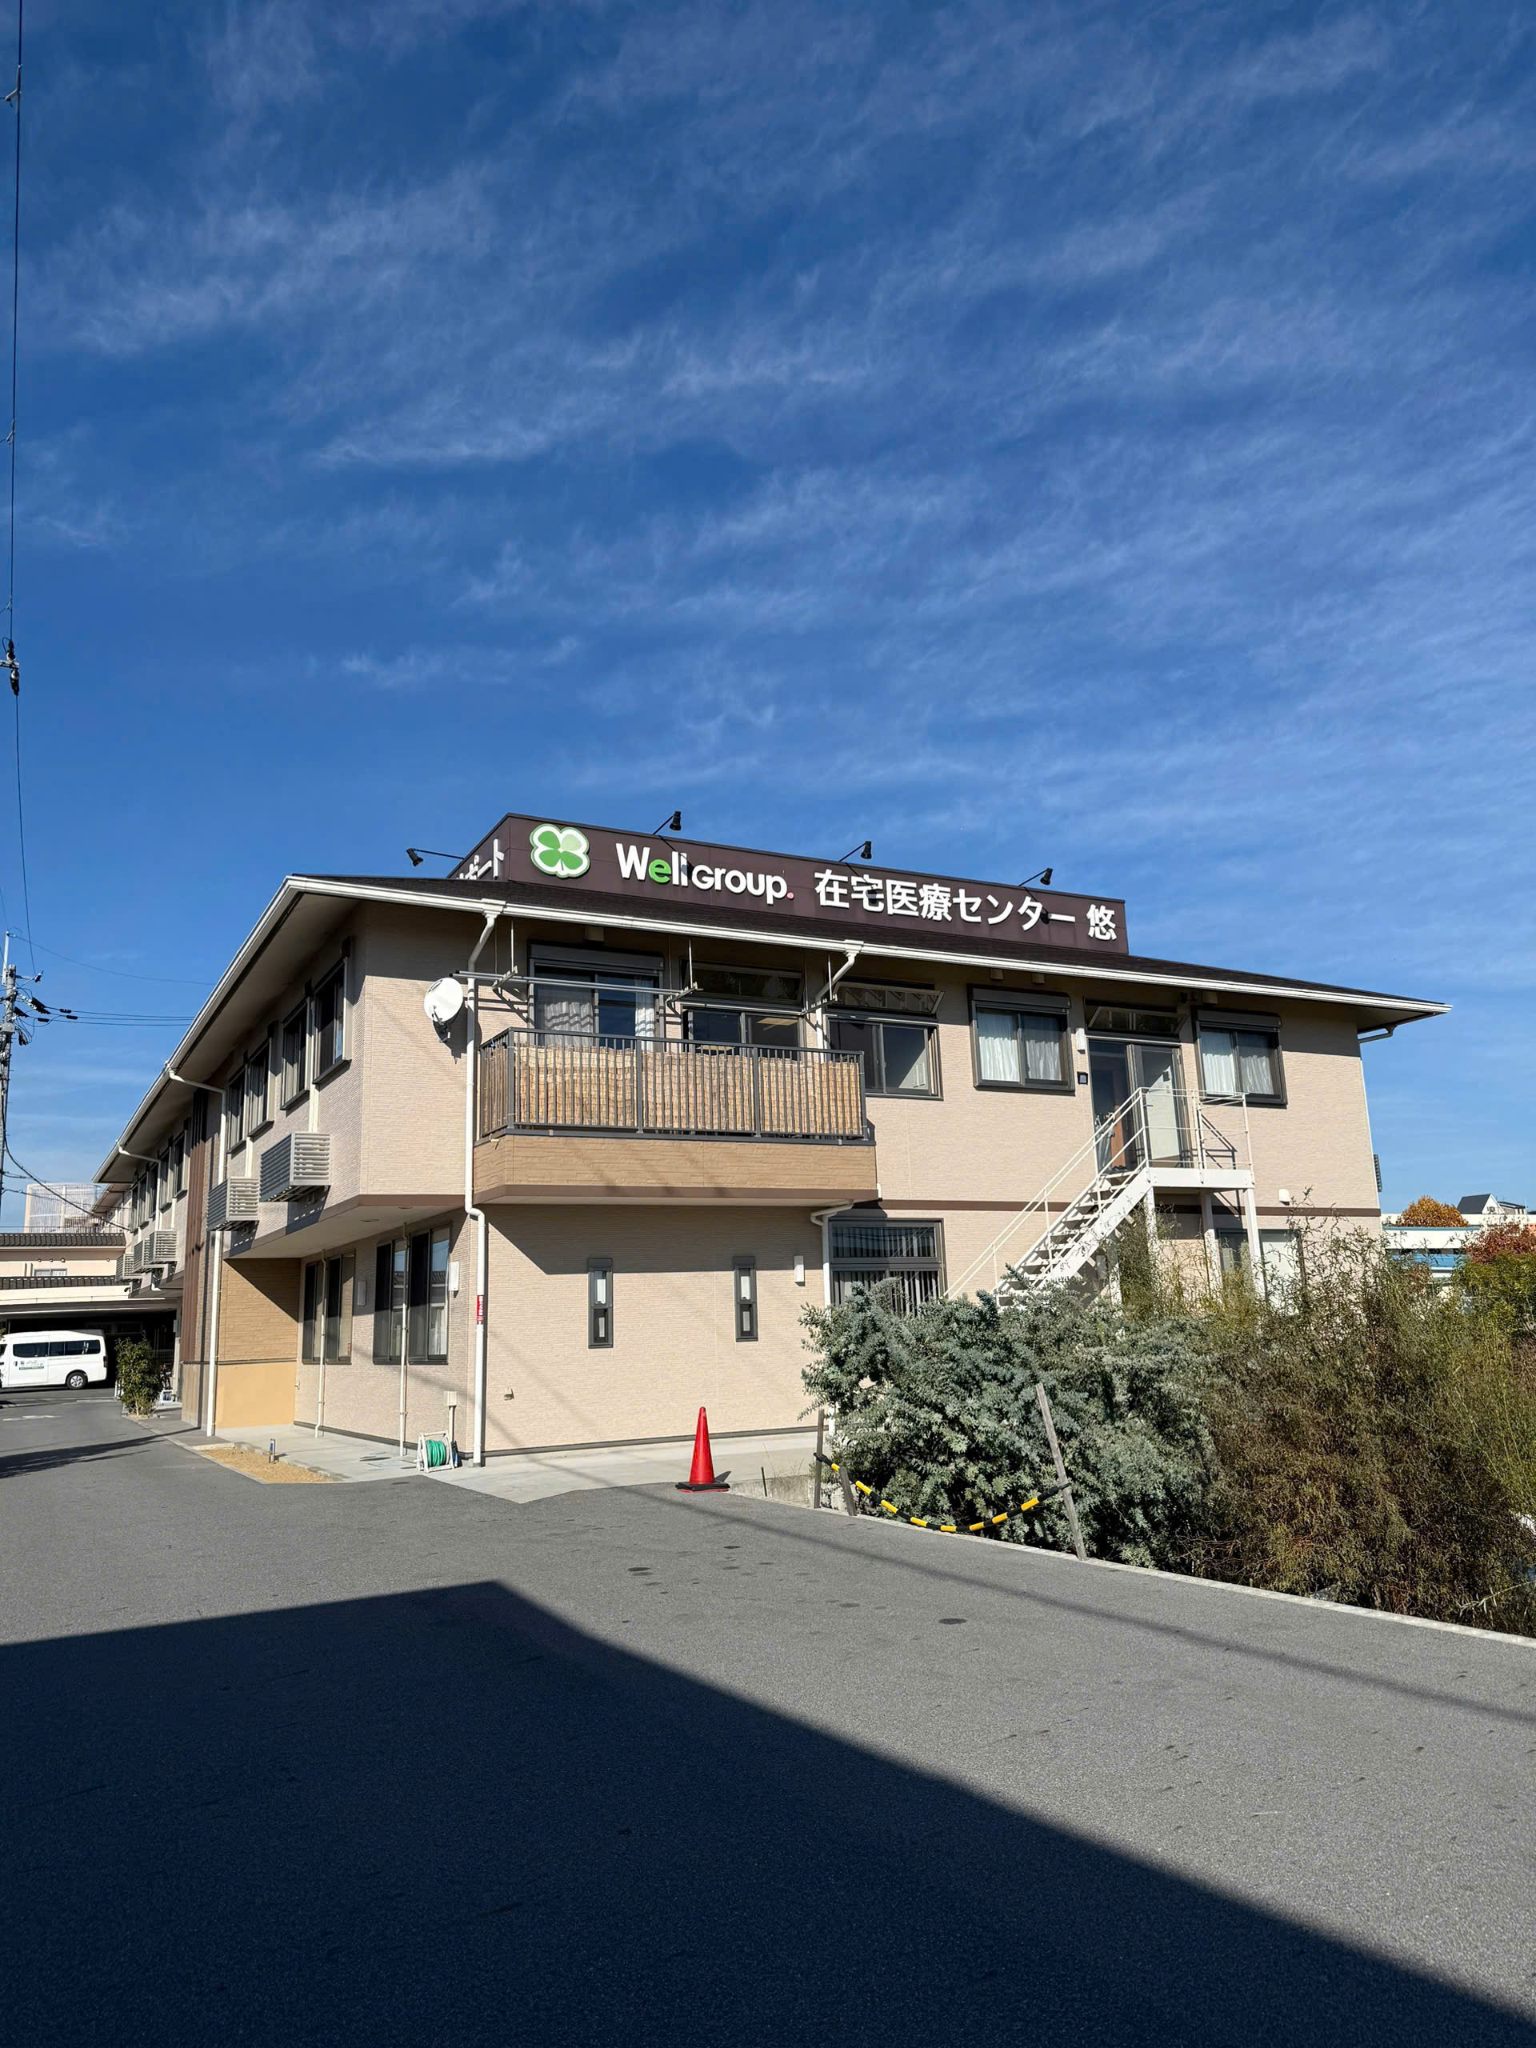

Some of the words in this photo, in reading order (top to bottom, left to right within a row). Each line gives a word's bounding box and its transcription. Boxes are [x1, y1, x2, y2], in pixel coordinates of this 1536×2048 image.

[814, 868, 1076, 931] 在宅医療センター
[1086, 904, 1118, 942] 悠
